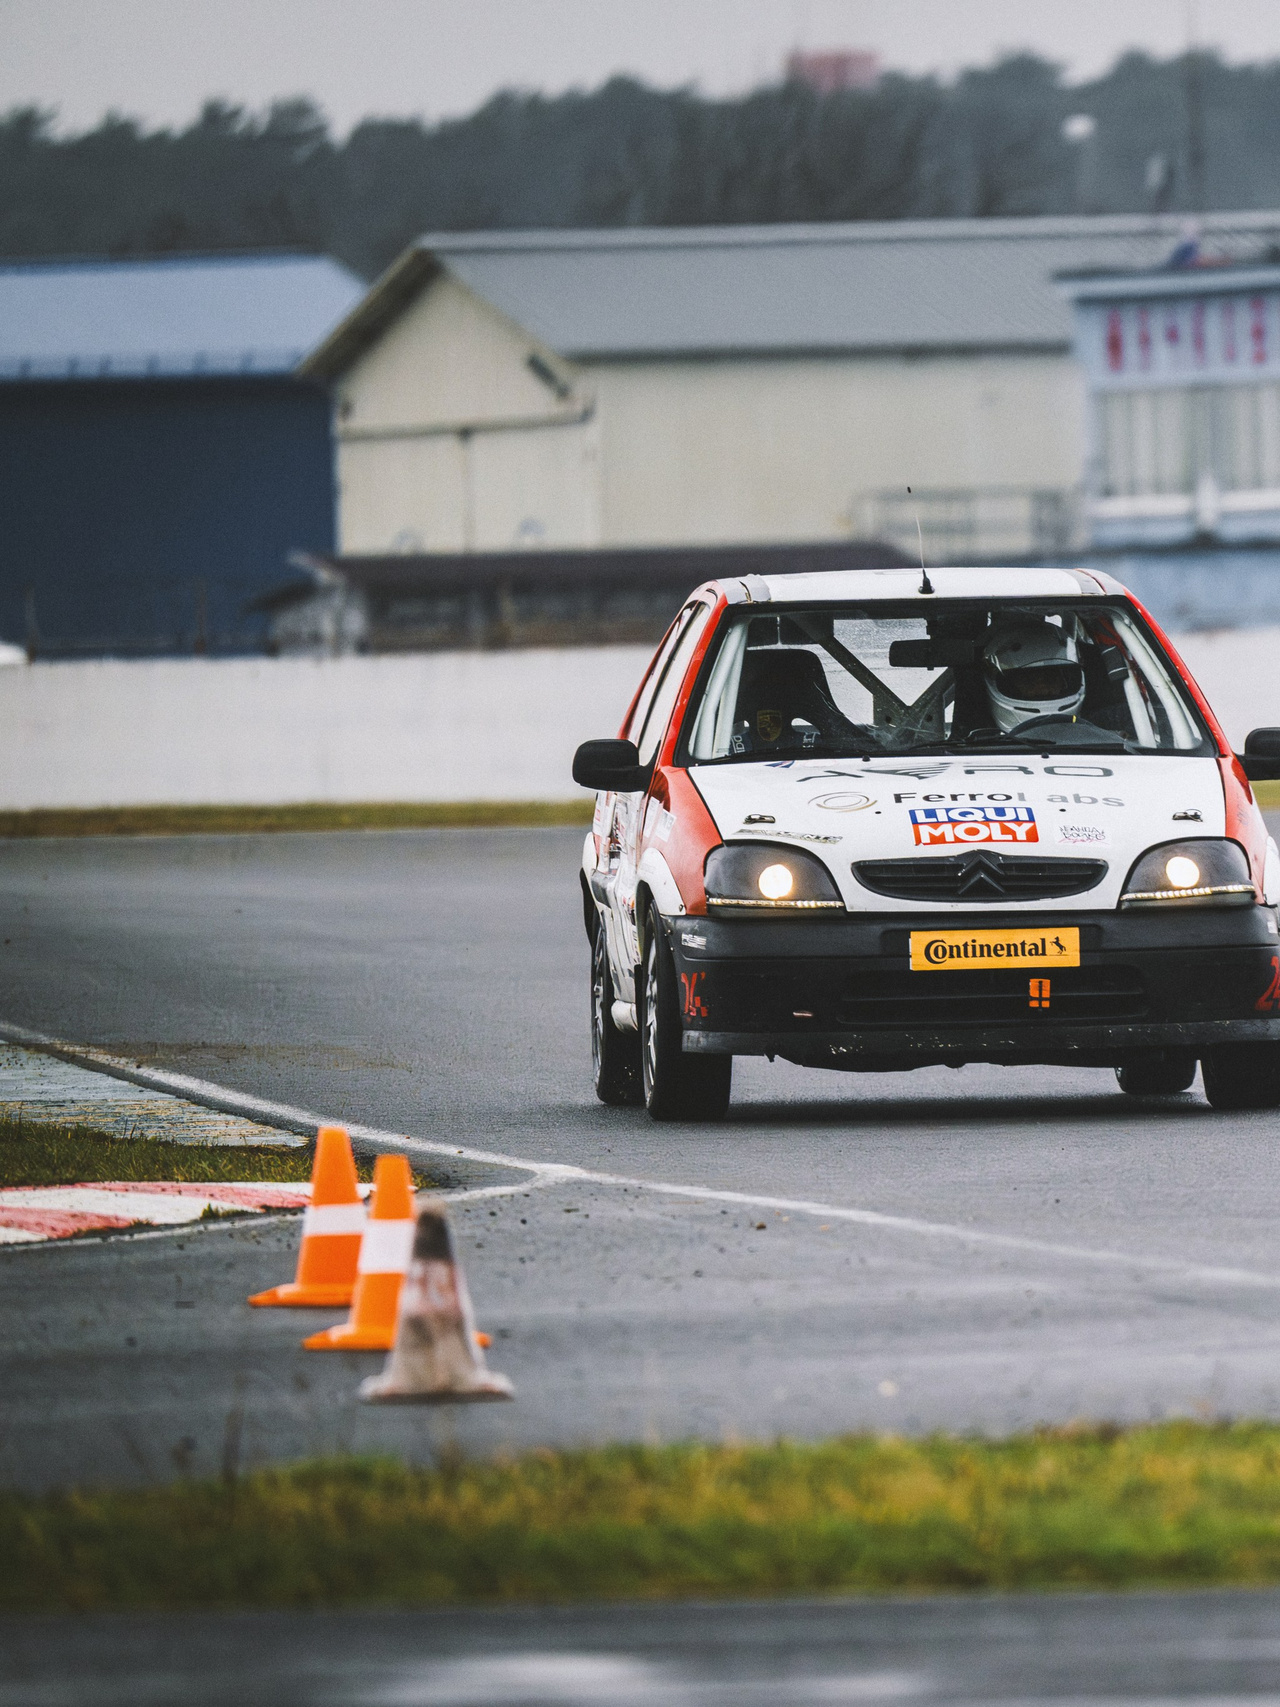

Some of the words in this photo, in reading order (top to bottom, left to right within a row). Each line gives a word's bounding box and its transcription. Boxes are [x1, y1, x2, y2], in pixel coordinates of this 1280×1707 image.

[916, 807, 1030, 823] LIQUI
[920, 822, 1035, 844] MOLY
[924, 937, 1047, 964] Continental
